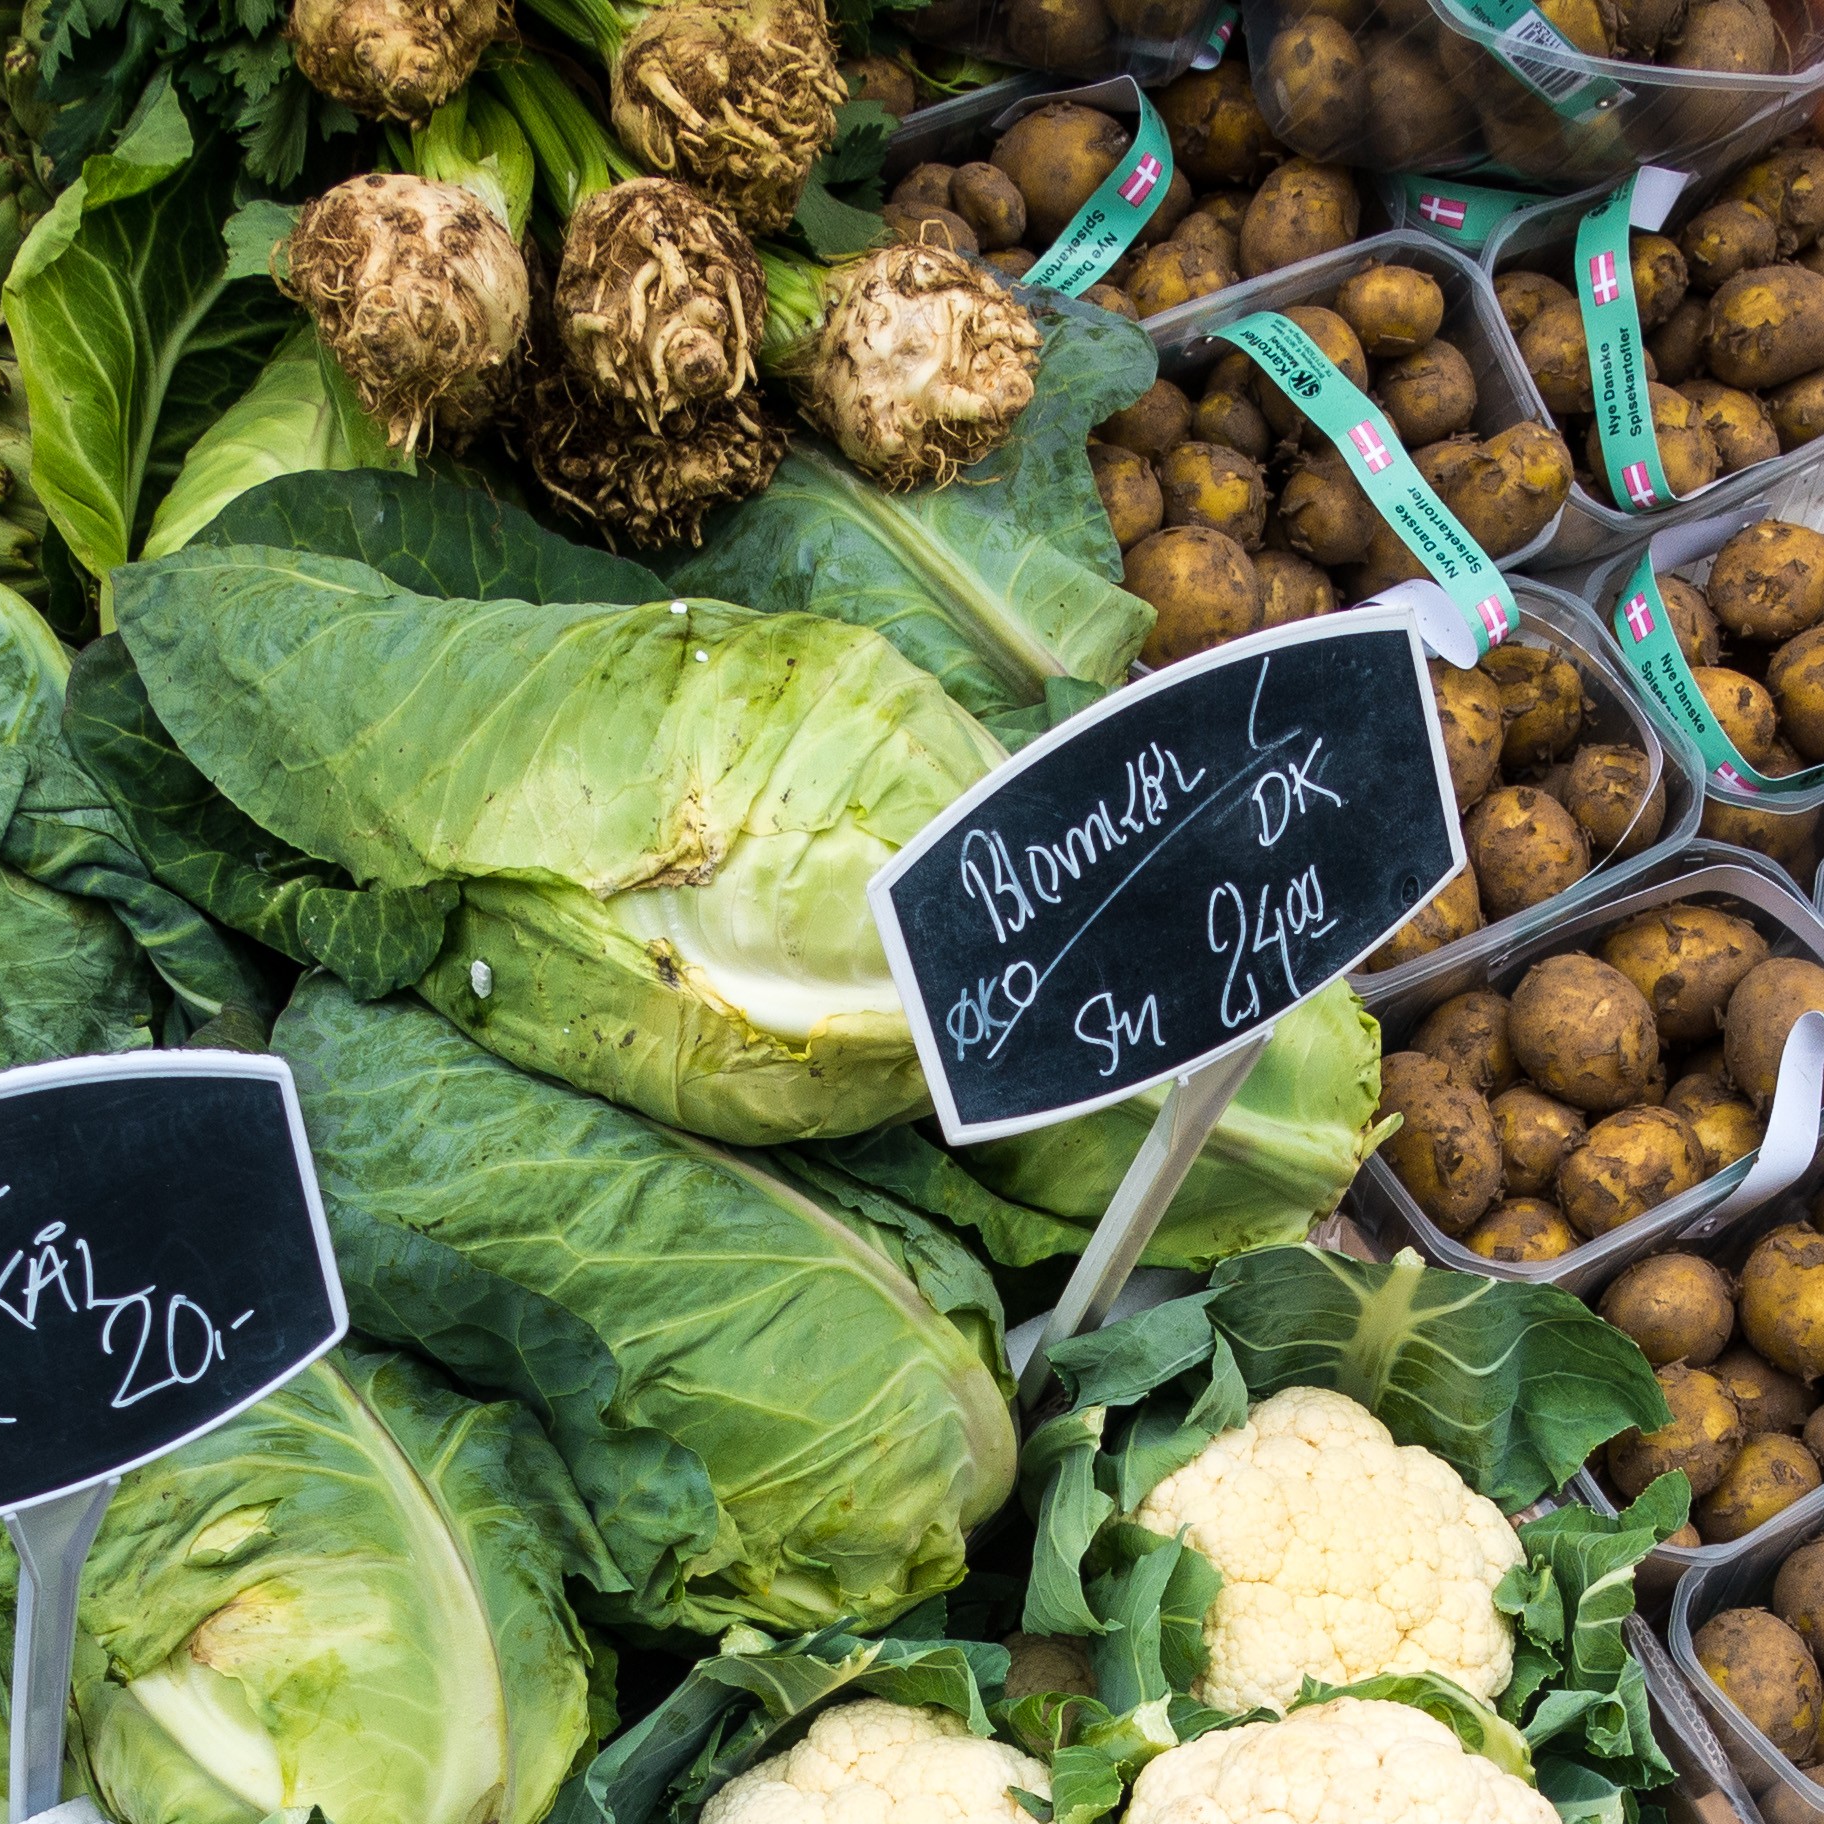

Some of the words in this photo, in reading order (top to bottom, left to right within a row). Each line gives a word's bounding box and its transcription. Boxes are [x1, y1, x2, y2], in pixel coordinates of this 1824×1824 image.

[1239, 331, 1291, 377] Kartofler
[1600, 342, 1617, 402] Danske
[1620, 327, 1643, 437] Spisekartofler
[1608, 406, 1621, 438] Nye
[1394, 504, 1438, 553] Danske
[1406, 487, 1483, 575] Spisekartofler
[1435, 552, 1460, 580] Nye
[1661, 652, 1677, 682] Nye
[1673, 681, 1707, 734] Danske
